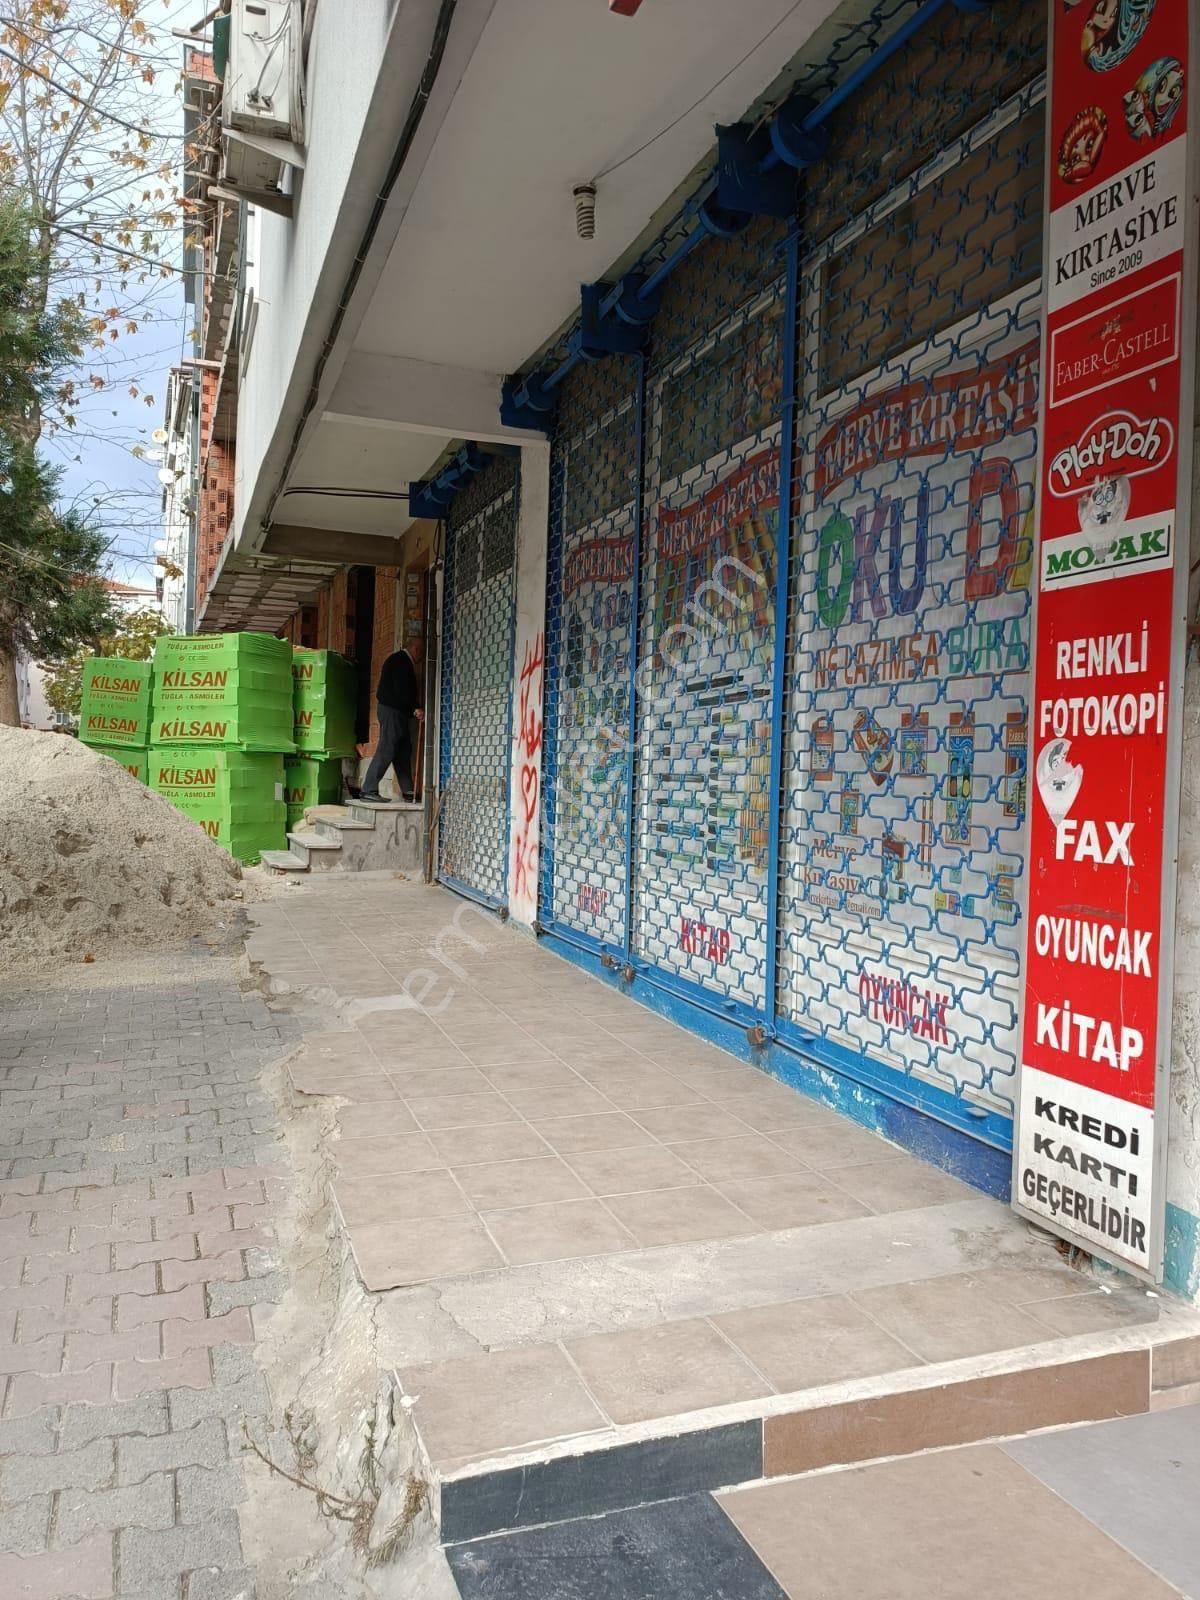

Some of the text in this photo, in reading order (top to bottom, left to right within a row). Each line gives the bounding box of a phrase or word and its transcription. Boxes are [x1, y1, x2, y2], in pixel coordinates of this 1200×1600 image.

[1074, 161, 1156, 232] MERVE
[1055, 196, 1177, 285] KIRTASİYE
[1090, 249, 1143, 288] Since 2009
[1056, 323, 1170, 387] FABER-CASTELL
[823, 403, 900, 483] MERVE
[1052, 418, 1161, 488] Play-Doh
[162, 668, 228, 687] KİLSAN
[1056, 620, 1149, 680] RENKLİ
[90, 673, 141, 692] KİLSAN
[1040, 681, 1165, 738] FOTOKOPİ
[88, 713, 138, 733] KİLSAN
[159, 718, 227, 738] KİLSAN
[158, 765, 216, 785] KİLSAN
[1055, 819, 1136, 866] FAX
[680, 916, 731, 965] KİTAP
[1035, 914, 1152, 979] OYUNCAK
[859, 970, 950, 1046] OYUNCAK
[1036, 1000, 1144, 1073] KİTAP
[1034, 1096, 1140, 1156] KREDİ
[1033, 1133, 1138, 1197] KARTI
[1022, 1167, 1146, 1253] GEÇERLİDİR
